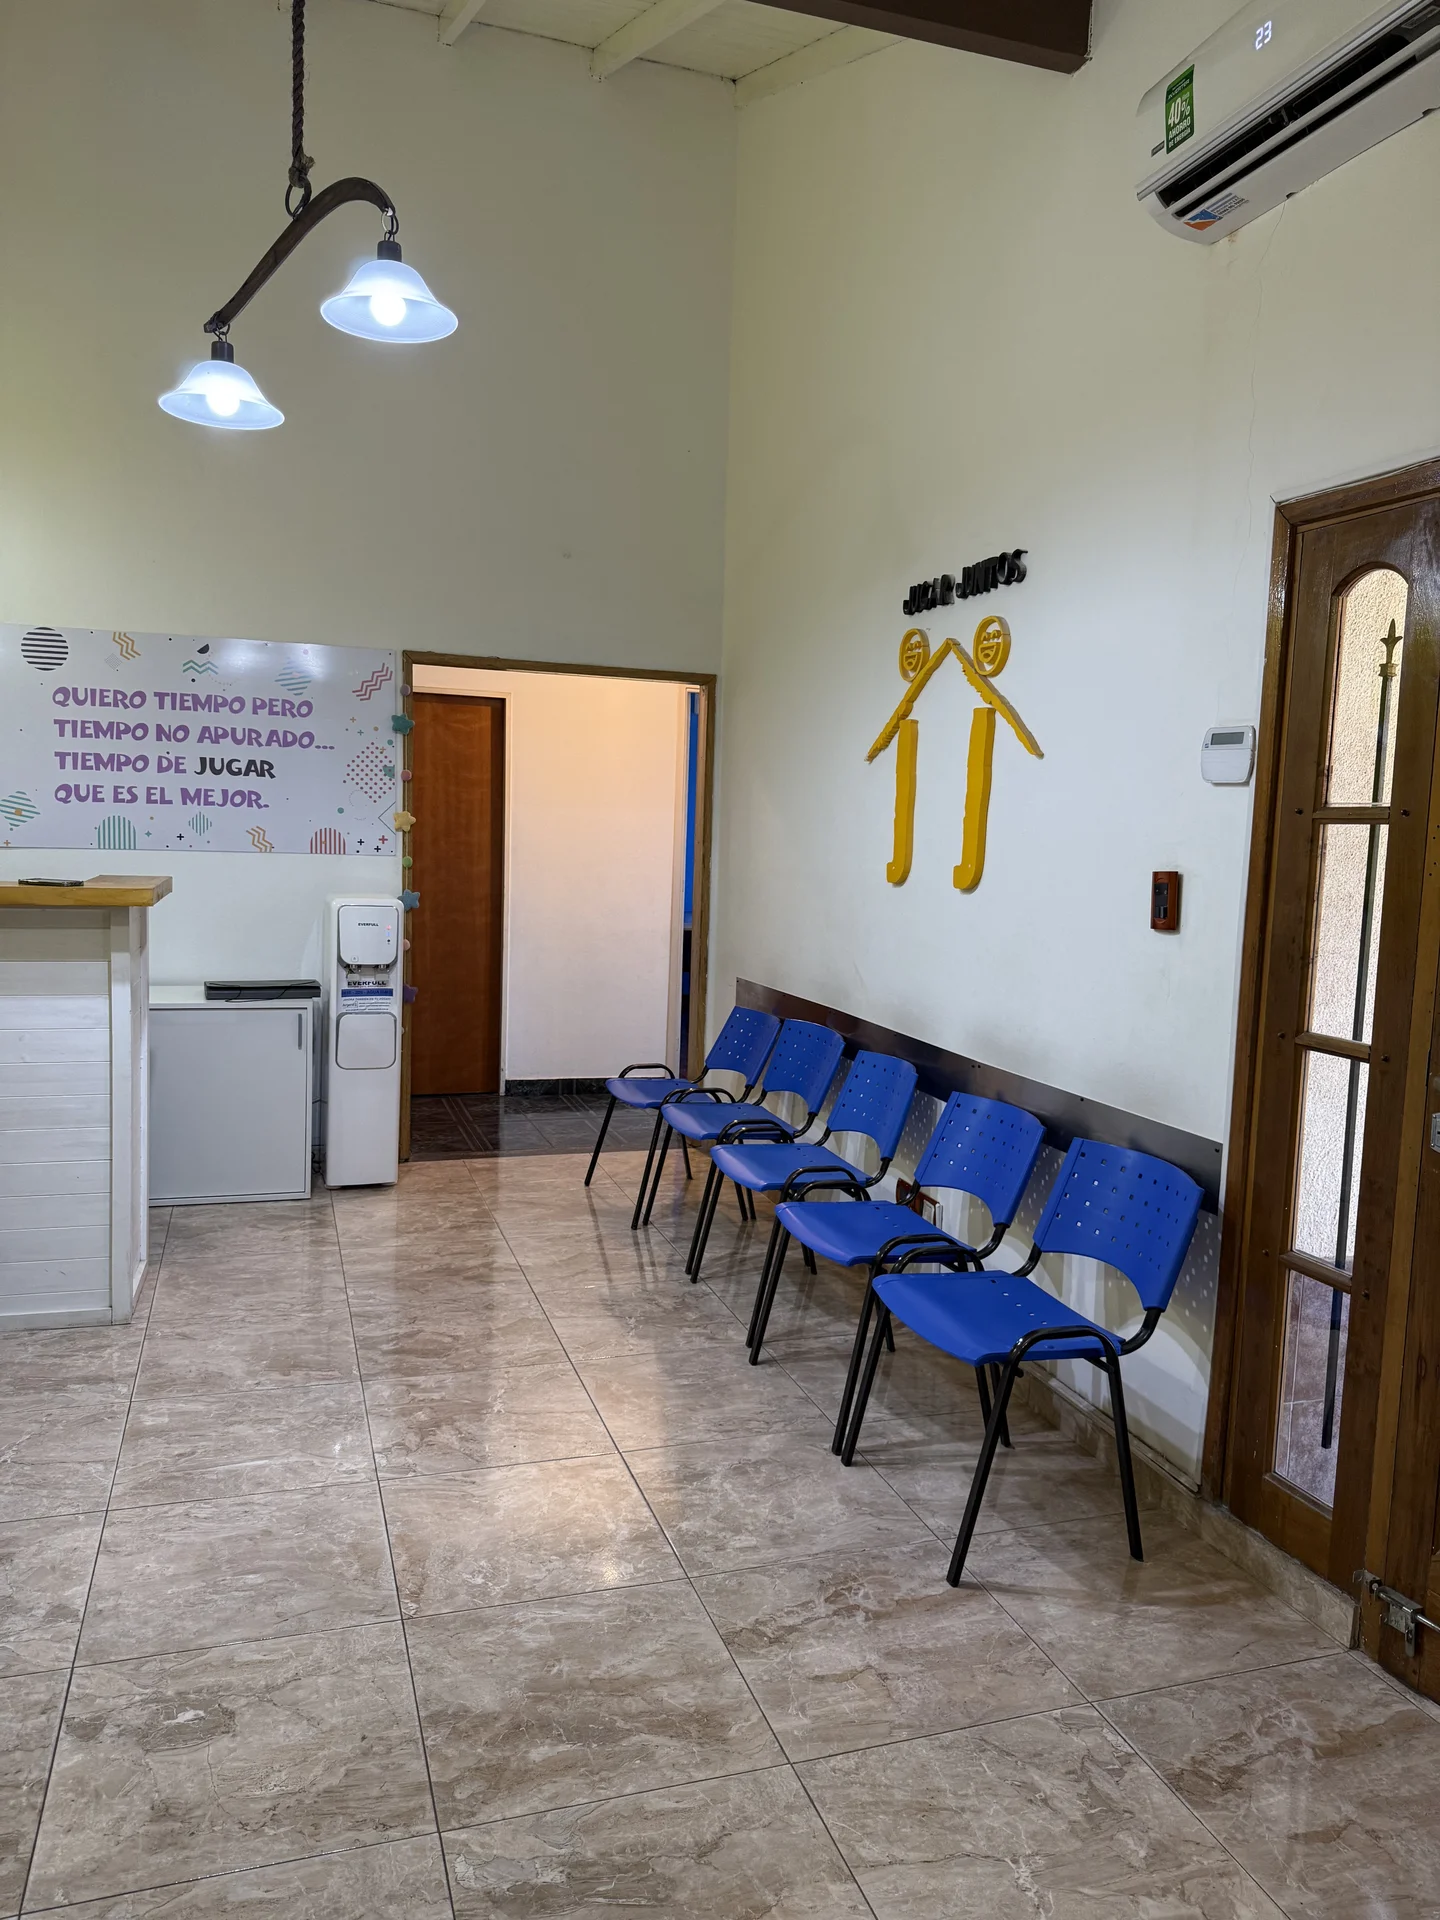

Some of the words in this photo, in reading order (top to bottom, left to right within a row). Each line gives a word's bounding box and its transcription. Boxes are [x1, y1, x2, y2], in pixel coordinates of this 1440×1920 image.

[1255, 20, 1272, 50] 23
[1168, 116, 1191, 140] AHORRO
[903, 574, 955, 615] JUGAR
[956, 549, 1028, 599] JUNTOS
[52, 686, 147, 710] QUIERO
[153, 691, 246, 714] TIEMPO
[252, 697, 314, 718] PERO
[53, 719, 149, 741] TIEMPO
[155, 723, 190, 743] NO
[197, 725, 335, 750] APURADO...
[54, 751, 150, 773] TIEMPO
[157, 755, 187, 774] DE
[194, 756, 276, 779] JUGAR
[54, 783, 105, 804] QUE
[113, 785, 138, 804] ES
[146, 786, 173, 805] EL
[180, 787, 270, 809] MEJOR.
